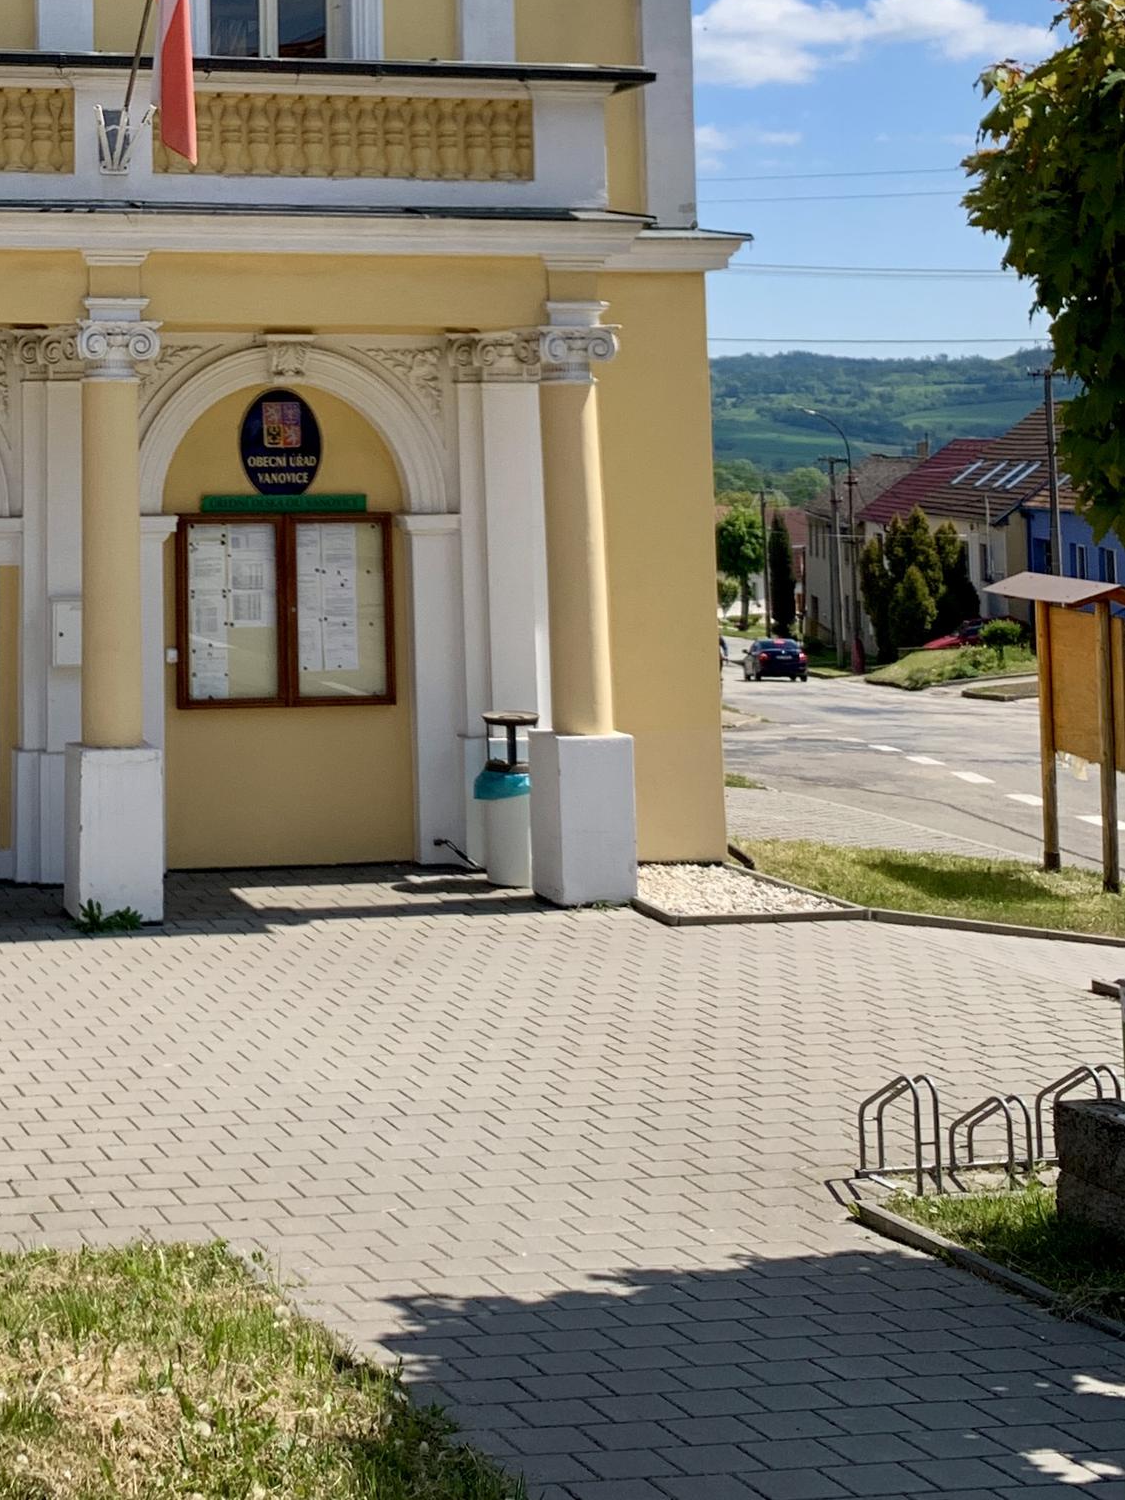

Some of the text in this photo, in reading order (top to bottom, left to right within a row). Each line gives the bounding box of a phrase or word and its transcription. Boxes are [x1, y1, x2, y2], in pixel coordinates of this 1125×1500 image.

[247, 453, 317, 468] OBECNÍ ÚŘAD
[258, 472, 309, 485] VANOVICE
